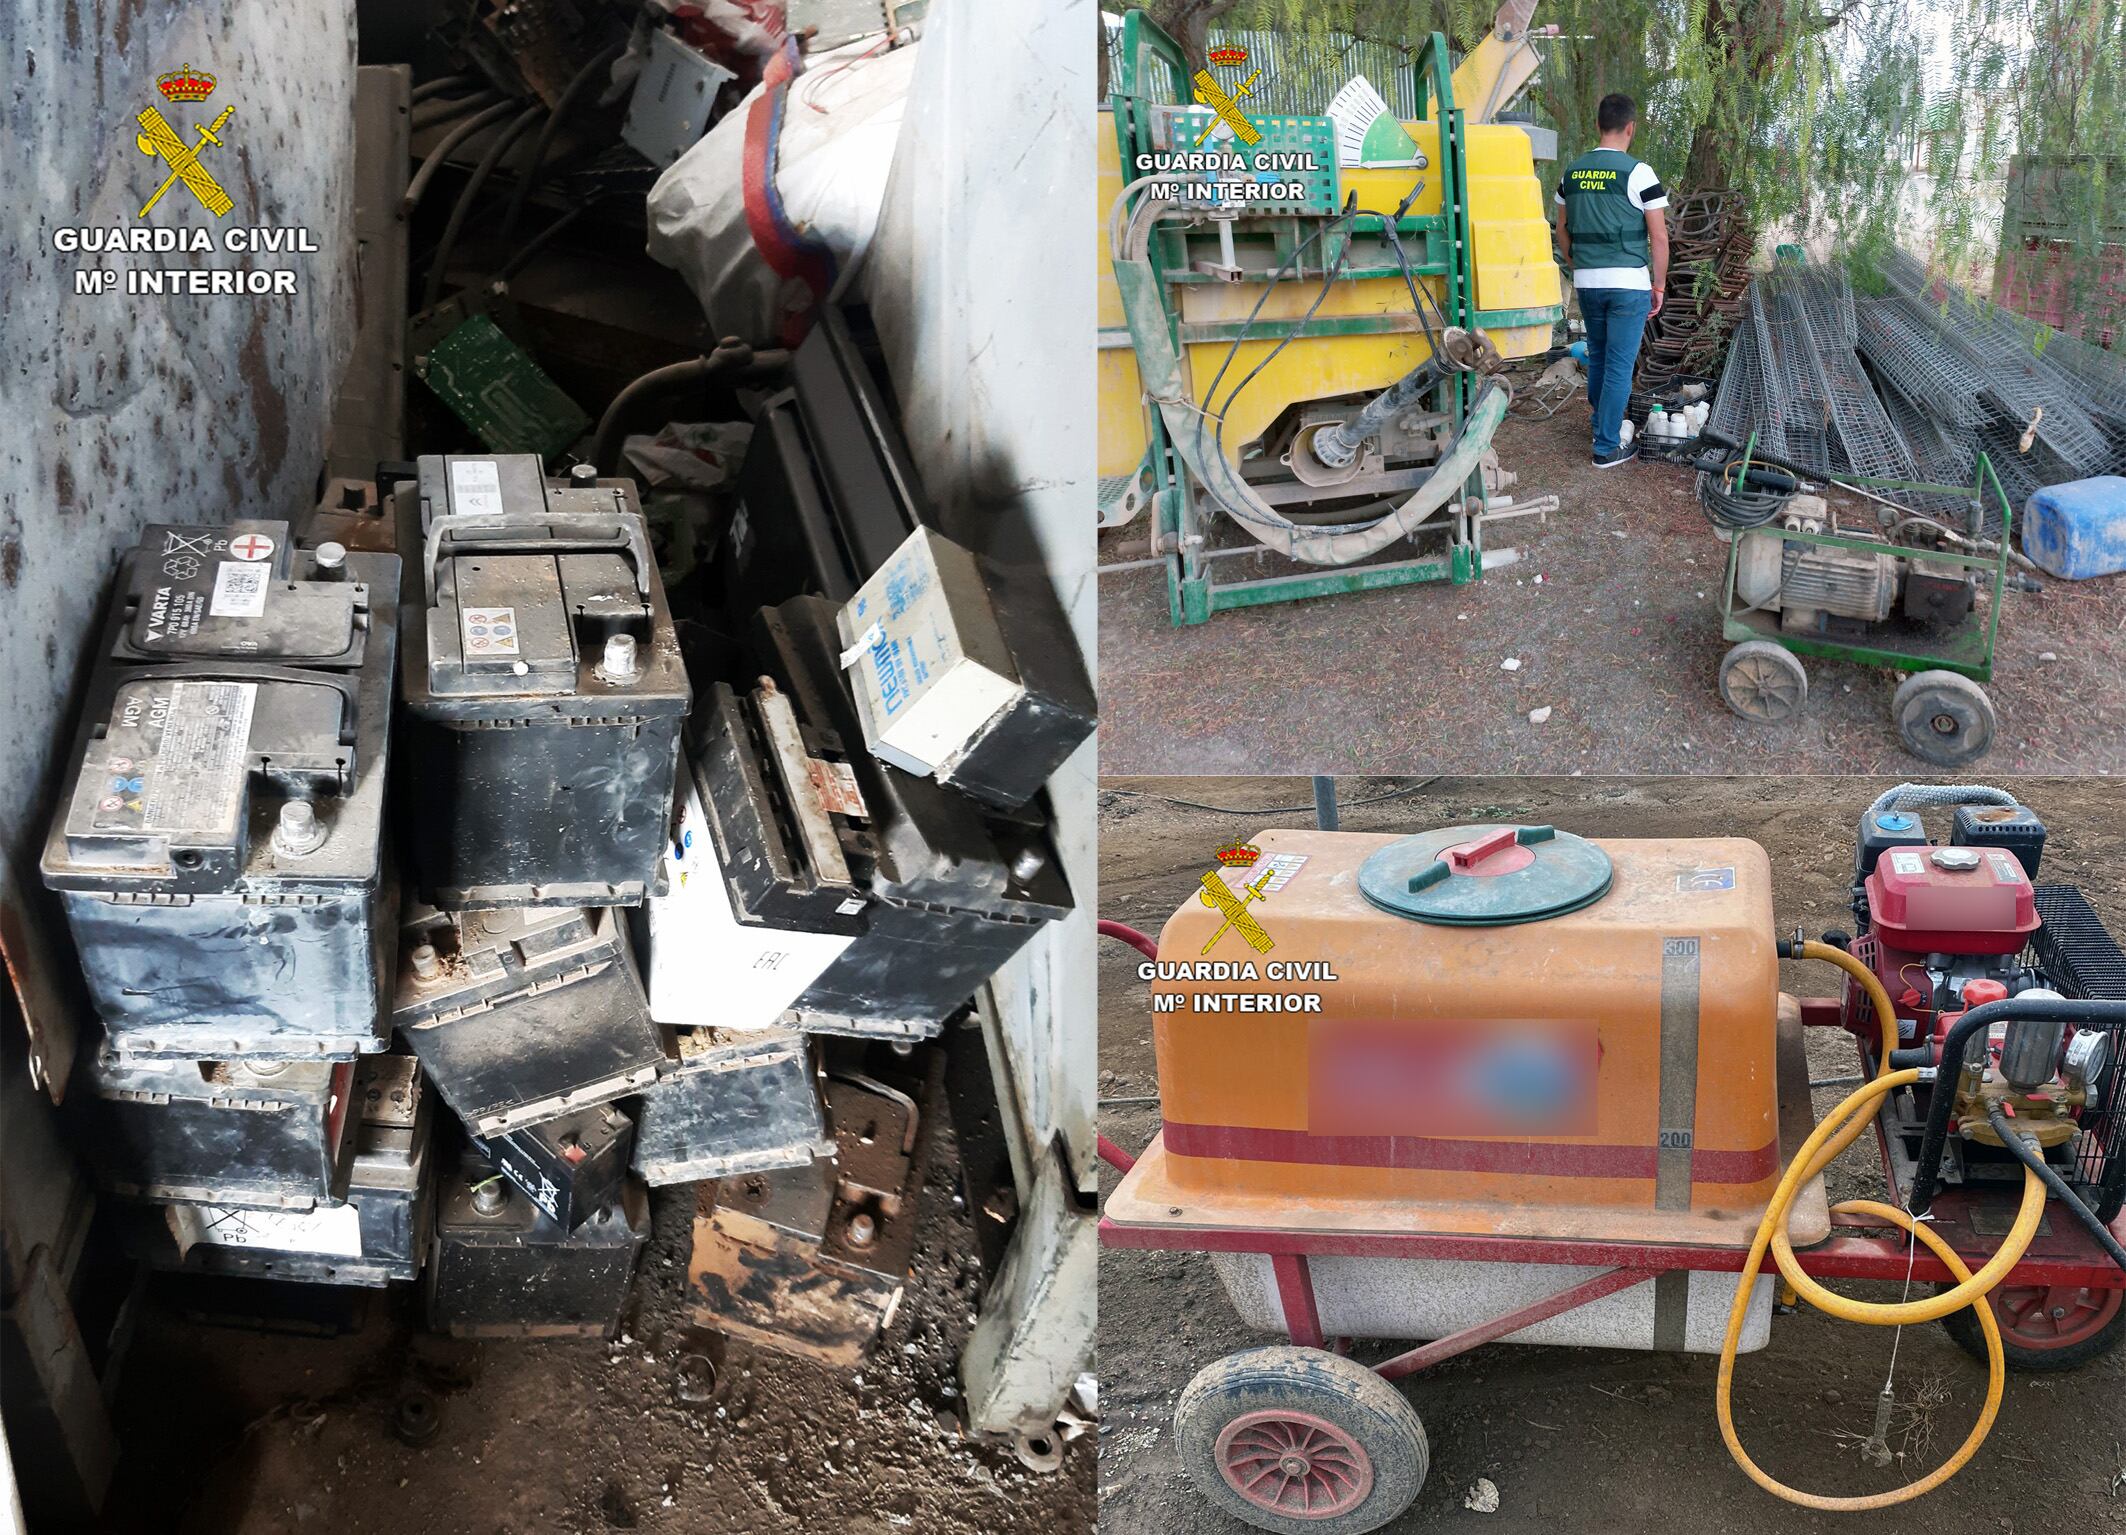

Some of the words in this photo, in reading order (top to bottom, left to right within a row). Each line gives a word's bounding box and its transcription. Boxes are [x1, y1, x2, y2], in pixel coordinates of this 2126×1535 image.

[1571, 170, 1617, 180] GUARDIA
[1579, 180, 1606, 190] CIVIL
[213, 539, 228, 552] Pb
[175, 594, 186, 607] 105
[149, 587, 172, 628] VARTA
[172, 607, 183, 620] 915
[121, 696, 143, 728] AGM
[149, 697, 170, 728] AGM
[1665, 940, 1696, 954] 300
[1660, 1132, 1691, 1147] 200
[539, 1191, 556, 1213] Pb
[223, 1233, 247, 1244] Pb
